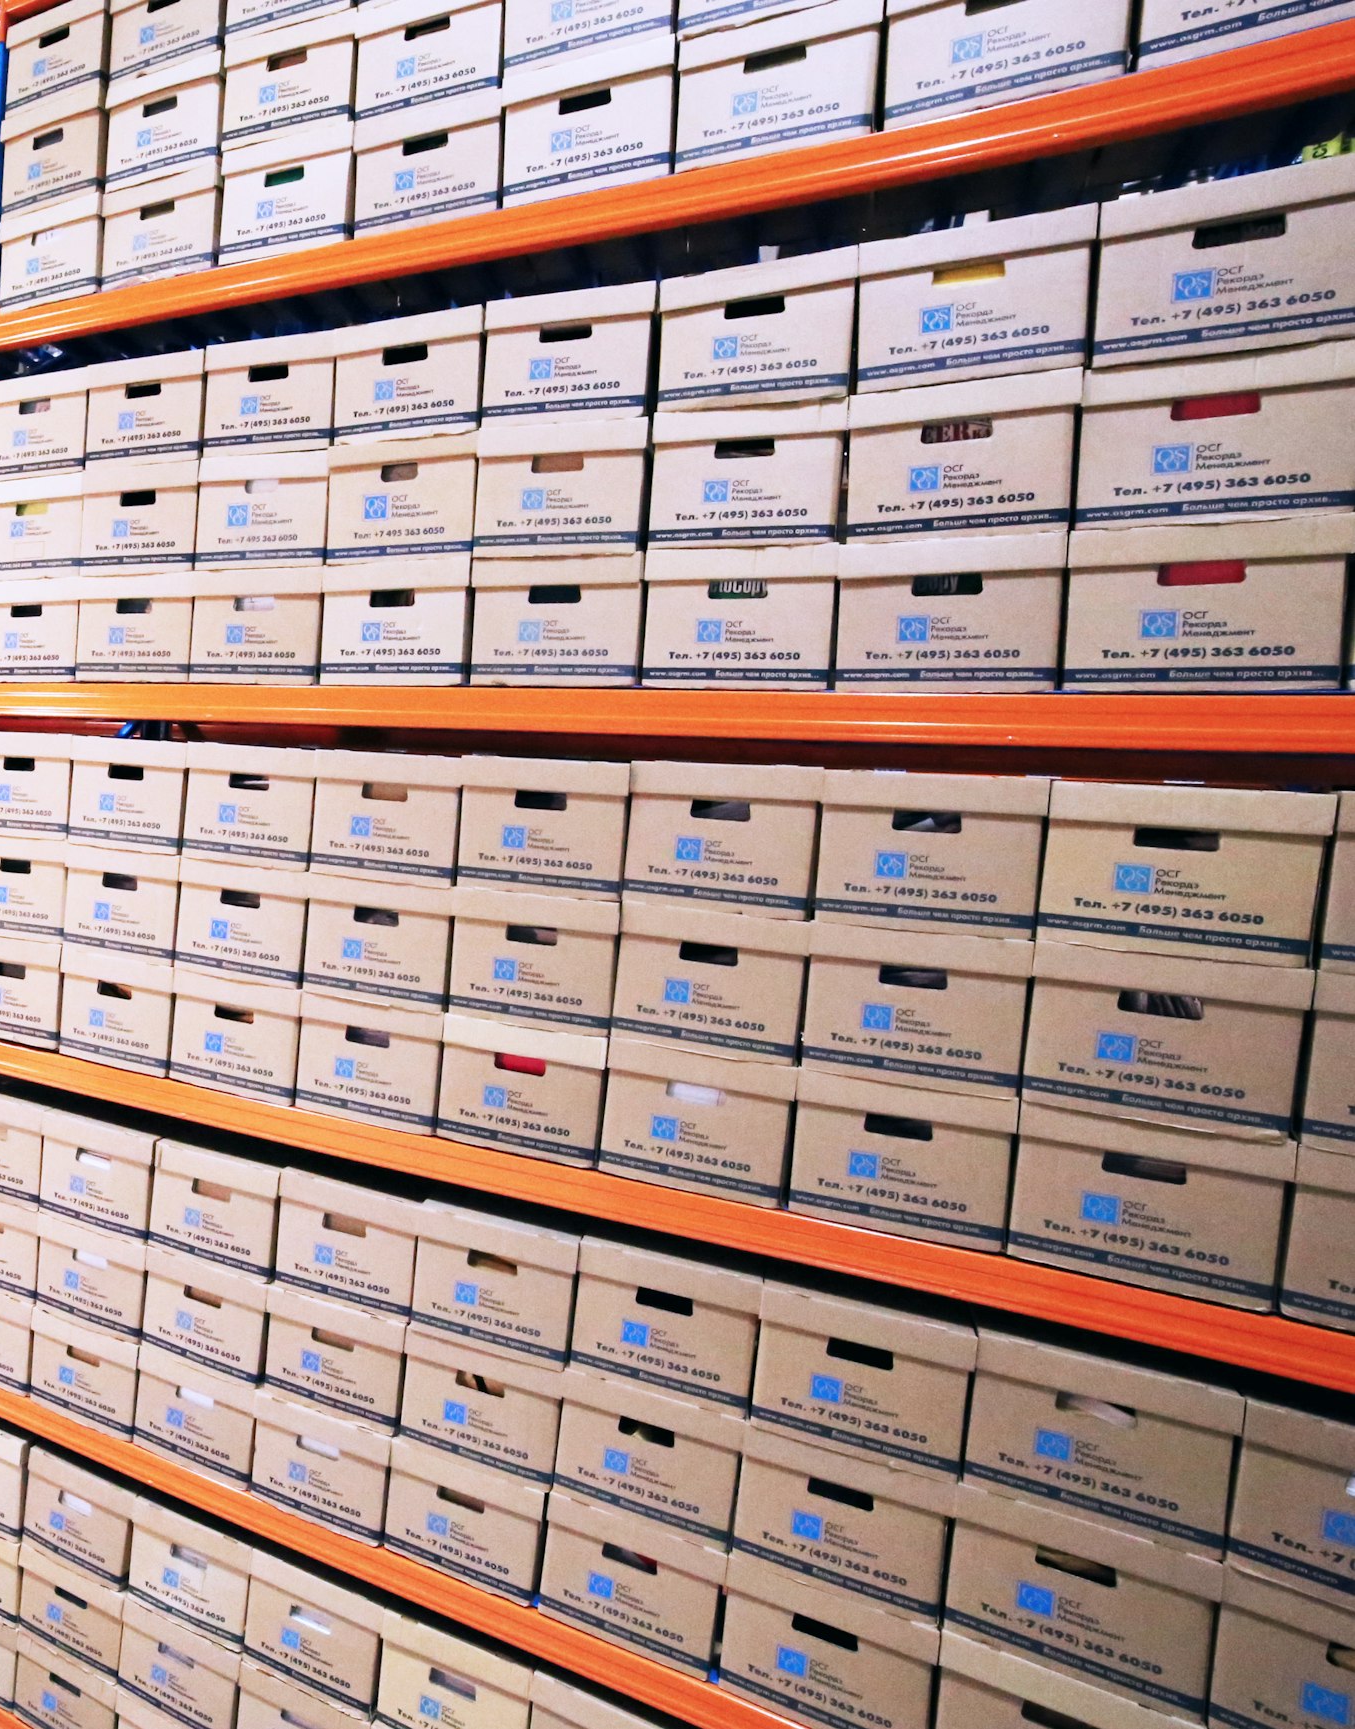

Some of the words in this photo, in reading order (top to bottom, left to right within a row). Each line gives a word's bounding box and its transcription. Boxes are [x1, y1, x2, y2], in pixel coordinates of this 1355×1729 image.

[984, 26, 1007, 40] ОСГ
[915, 79, 945, 90] Тел.
[949, 69, 966, 80] +7
[970, 59, 1007, 78] (495)
[1010, 52, 1040, 66] 363
[1044, 39, 1086, 57] 6050
[1217, 264, 1245, 277] ОСГ
[1130, 317, 1165, 327] Тел.
[1170, 309, 1192, 320] +7
[1195, 302, 1241, 320] (495)
[1245, 298, 1281, 311] 363
[1286, 289, 1337, 305] 6050
[1196, 442, 1223, 453] ОСГ
[943, 462, 964, 472] ОСГ
[1112, 487, 1146, 497] Тел.
[1151, 483, 1172, 493] +7
[1176, 479, 1220, 494] (495)
[1224, 478, 1259, 488] 363
[1264, 472, 1313, 485] 6050
[876, 503, 905, 512] Тел.
[908, 499, 925, 509] +7
[928, 497, 963, 510] (495)
[966, 496, 993, 505] 363
[996, 491, 1033, 503] 6050
[1182, 613, 1208, 622] ОСГ
[1100, 650, 1134, 659] Тел.
[1139, 648, 1160, 658] +7
[1163, 647, 1206, 660] (495)
[1210, 647, 1244, 656] 363
[1248, 646, 1295, 656] 6050
[1155, 870, 1181, 879] ОСГ
[1073, 897, 1106, 909] Тел.
[1111, 902, 1131, 911] +7
[1134, 903, 1177, 918] (495)
[1181, 908, 1214, 920] 363
[1218, 912, 1265, 925] 6050
[1138, 1038, 1163, 1048] ОСГ
[1057, 1062, 1090, 1075] Тел.
[1094, 1068, 1114, 1078] +7
[1117, 1070, 1159, 1088] (495)
[1163, 1078, 1196, 1091] 363
[1200, 1084, 1247, 1099] 6050
